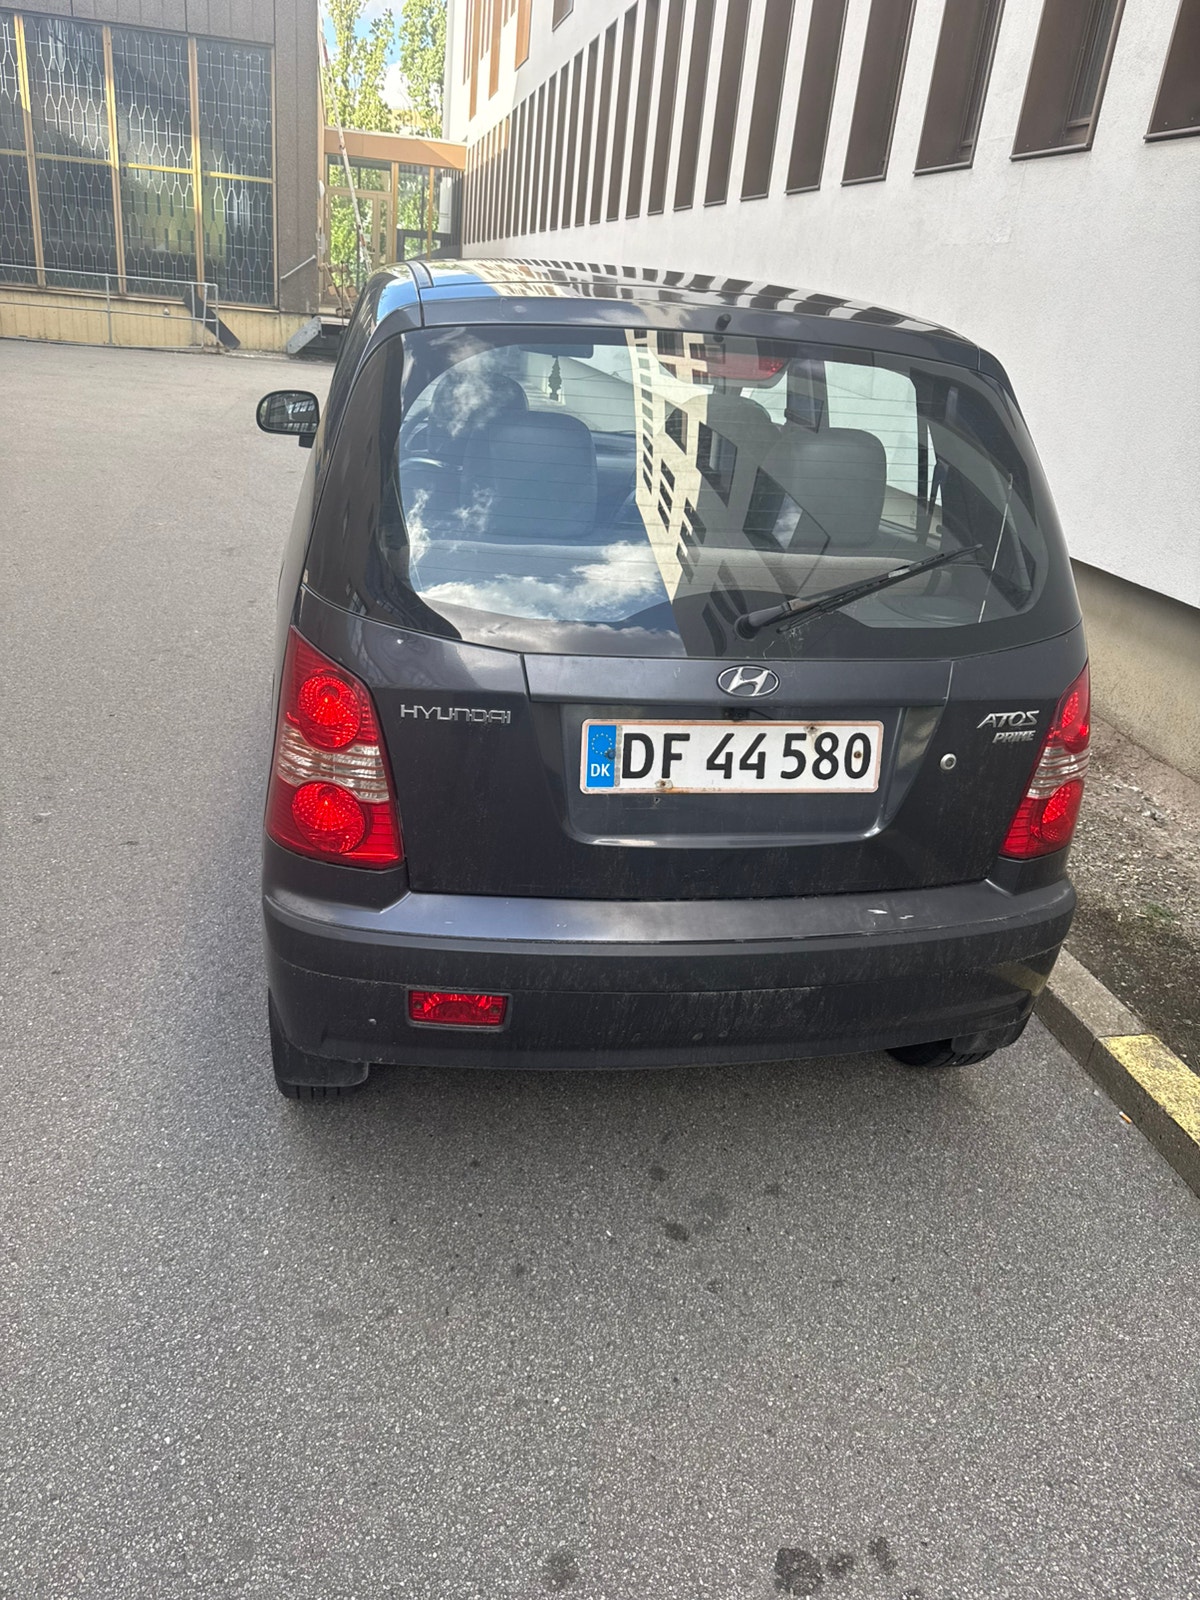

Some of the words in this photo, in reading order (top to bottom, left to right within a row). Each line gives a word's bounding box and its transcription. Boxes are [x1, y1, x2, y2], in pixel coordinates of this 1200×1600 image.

[400, 704, 511, 724] HYUNDAI
[976, 710, 1040, 729] ATOS
[992, 730, 1036, 743] PRIME
[621, 732, 690, 779] DF
[706, 732, 767, 779] 44
[780, 731, 872, 780] 580
[590, 763, 610, 777] DK
